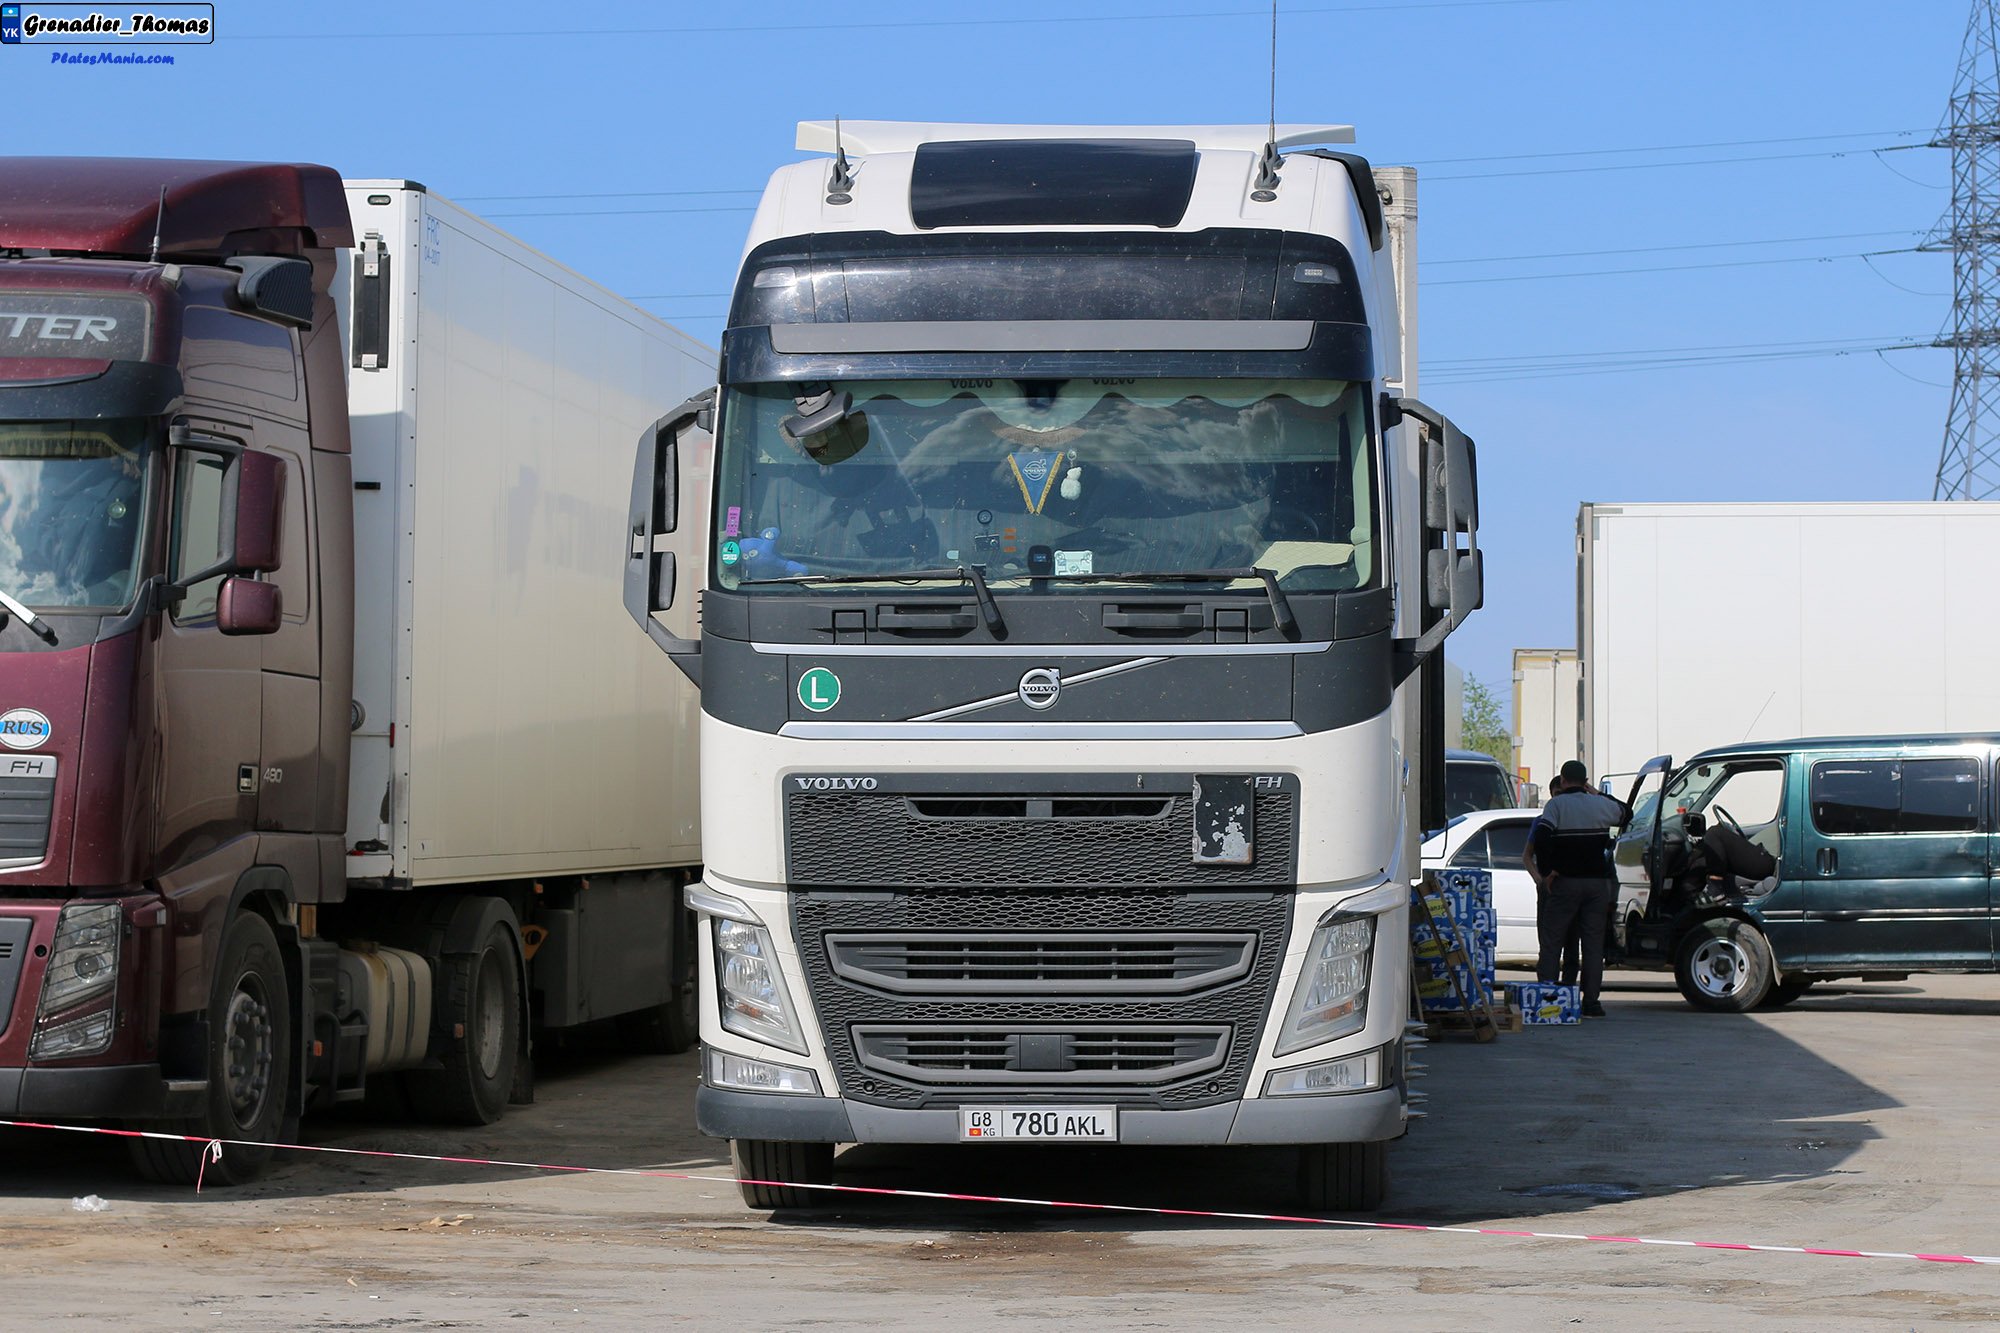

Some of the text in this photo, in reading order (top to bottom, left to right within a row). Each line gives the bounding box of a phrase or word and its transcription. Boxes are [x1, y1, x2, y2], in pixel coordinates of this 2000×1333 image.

[0, 313, 117, 341] TER
[951, 379, 993, 389] VOLVO
[811, 676, 829, 703] L
[2, 720, 43, 735] RUS
[10, 761, 43, 774] FH
[795, 777, 878, 790] VOLVO
[1254, 776, 1282, 788] FH
[971, 1112, 992, 1127] 08
[1012, 1112, 1105, 1136] 780 AKL
[983, 1128, 996, 1137] KG
